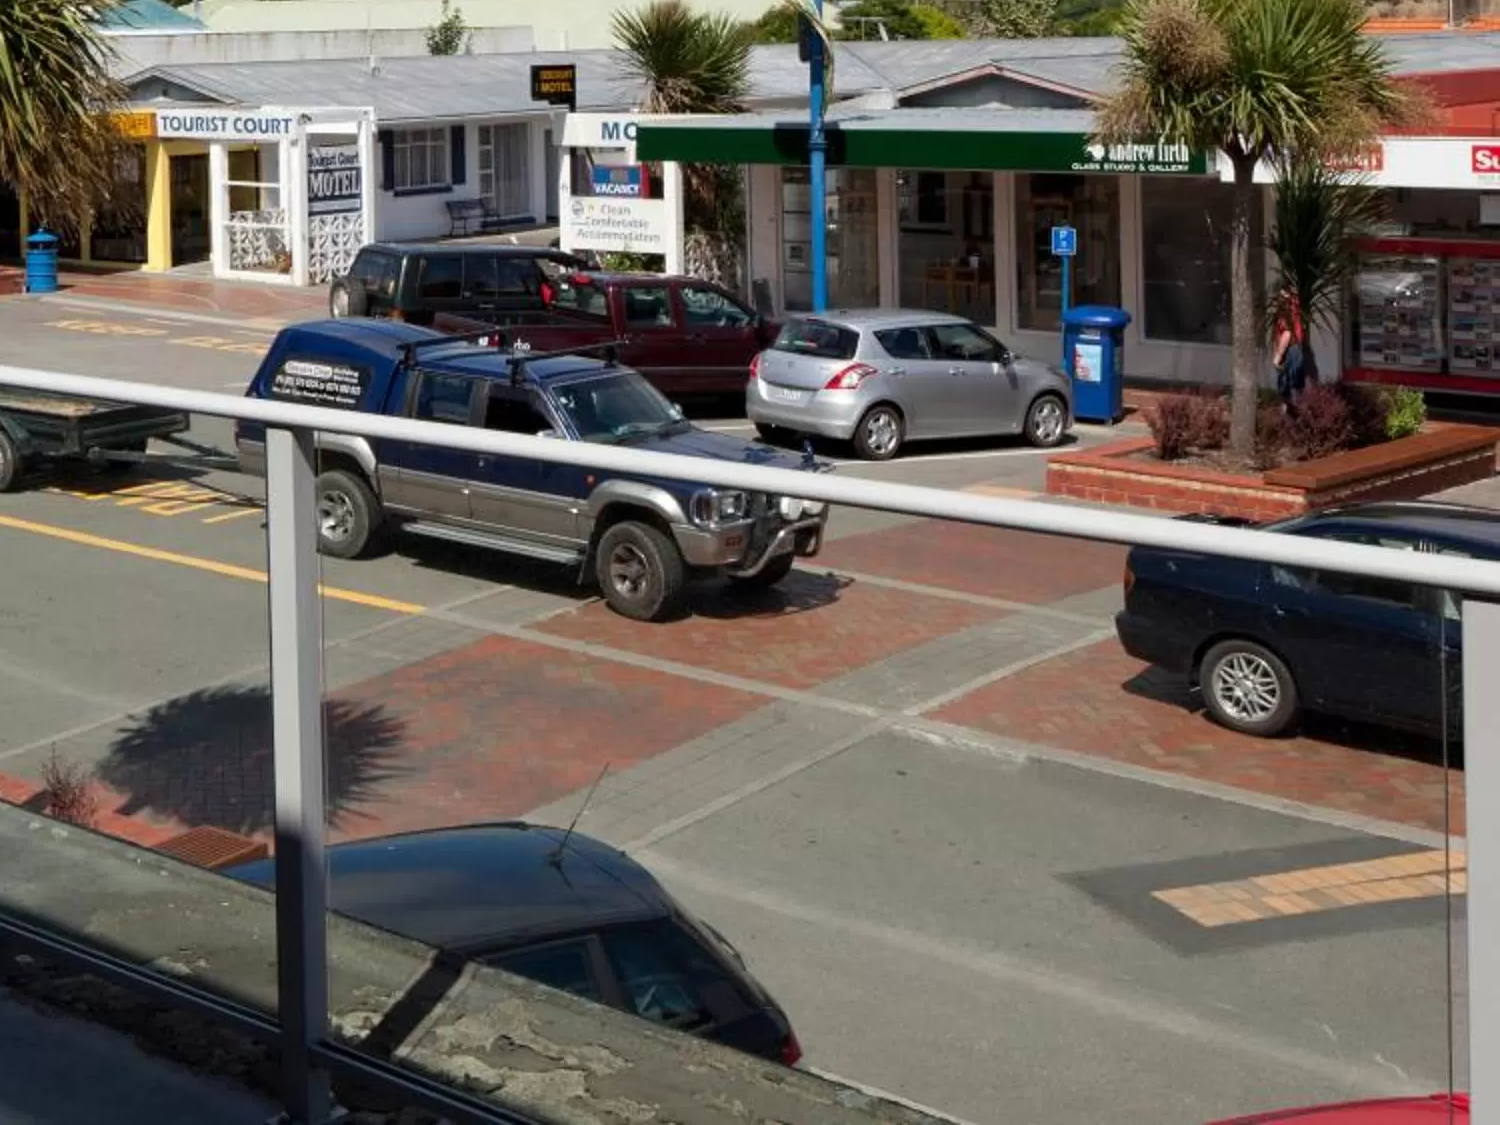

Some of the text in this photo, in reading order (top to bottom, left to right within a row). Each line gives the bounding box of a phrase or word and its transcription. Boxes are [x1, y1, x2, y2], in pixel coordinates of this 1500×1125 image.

[540, 82, 573, 93] MOTEL
[161, 116, 228, 133] TOURIST
[233, 117, 293, 134] COURT
[1107, 136, 1189, 162] andrew firth
[308, 151, 359, 167] Tourist Court
[1071, 162, 1189, 172] GLASS STUDIO & GALLERY
[309, 170, 361, 197] MOTEL
[593, 183, 641, 195] VACANCY
[600, 204, 632, 216] Clean
